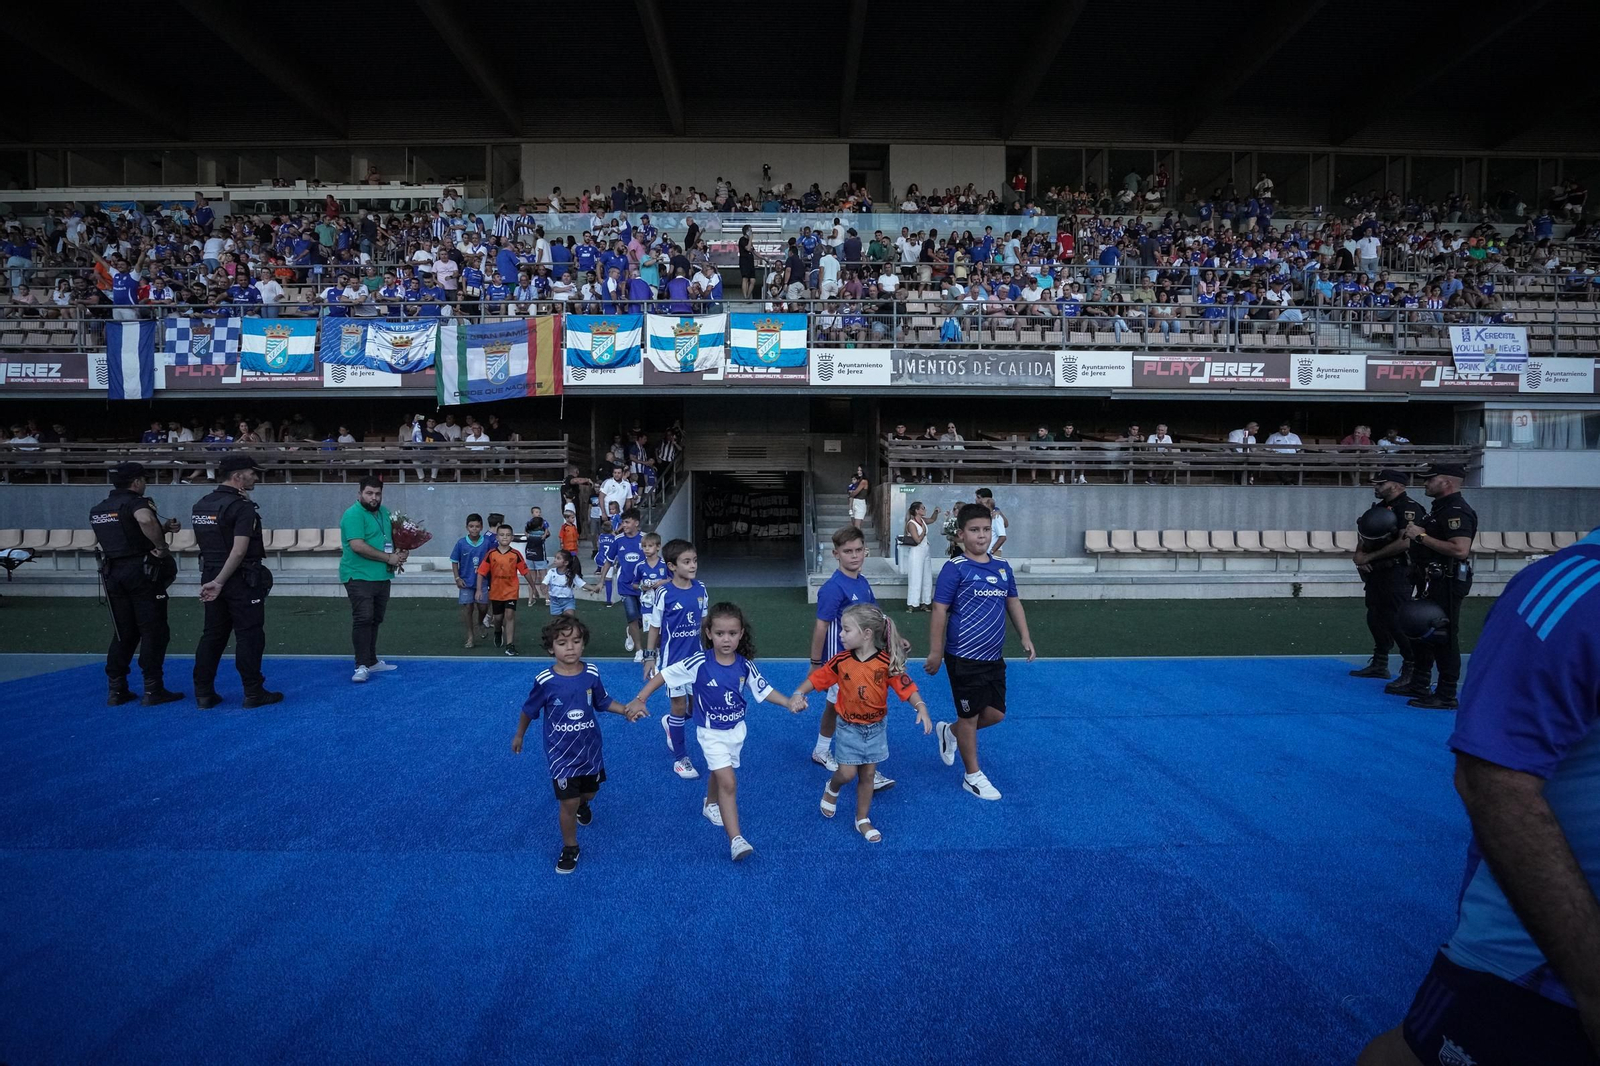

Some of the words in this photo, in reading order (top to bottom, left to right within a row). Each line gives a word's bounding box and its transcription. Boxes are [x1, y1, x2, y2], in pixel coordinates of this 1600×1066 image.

[711, 241, 739, 252] PLA
[390, 324, 416, 332] XEREZ
[175, 365, 229, 376] PLAY
[1143, 362, 1199, 375] PLAY
[1189, 361, 1265, 383] JEREZ
[1376, 366, 1430, 379] PLAY
[1458, 363, 1480, 371] DRINK
[485, 387, 504, 395] QUE
[603, 545, 609, 556] 7
